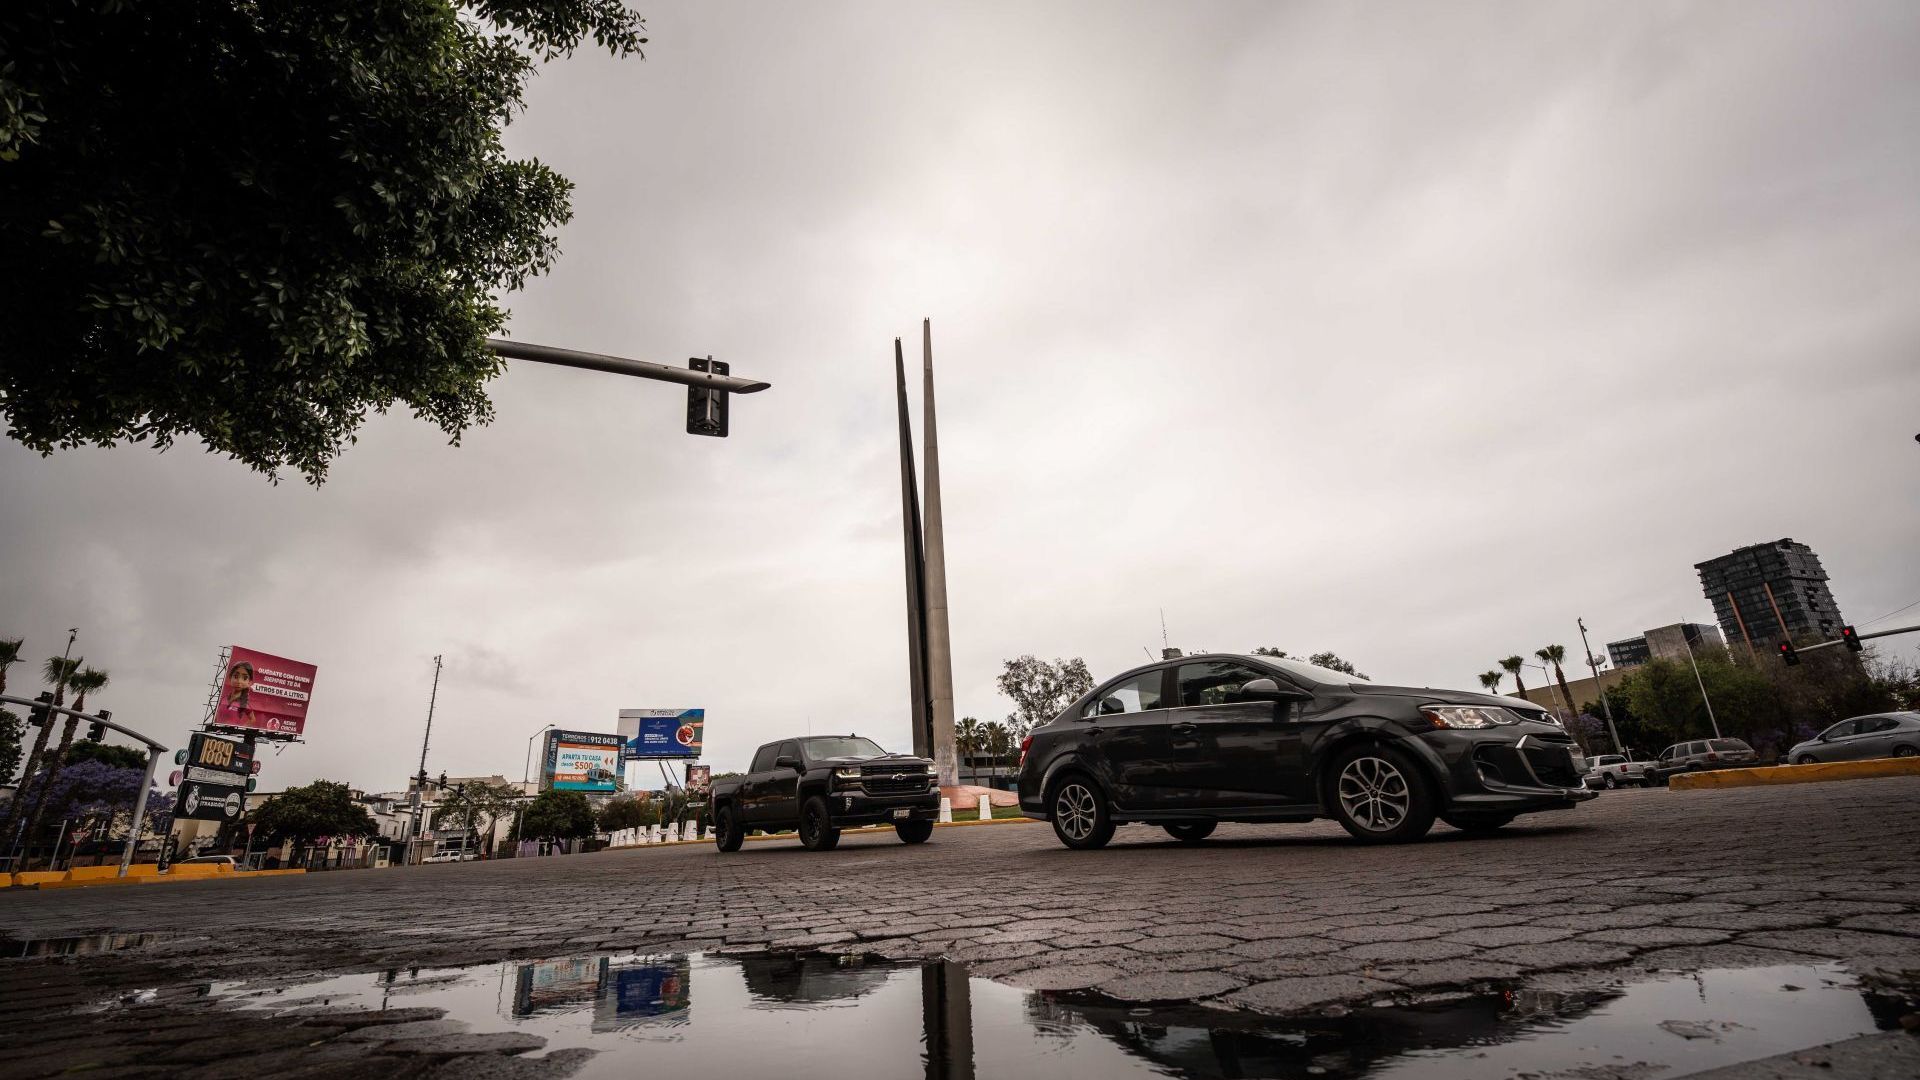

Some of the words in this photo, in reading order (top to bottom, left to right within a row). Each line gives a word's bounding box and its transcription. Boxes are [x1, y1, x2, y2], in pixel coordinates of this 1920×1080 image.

[263, 676, 286, 685] SIEMPRE
[255, 685, 275, 694] LITROS
[590, 736, 602, 744] 912
